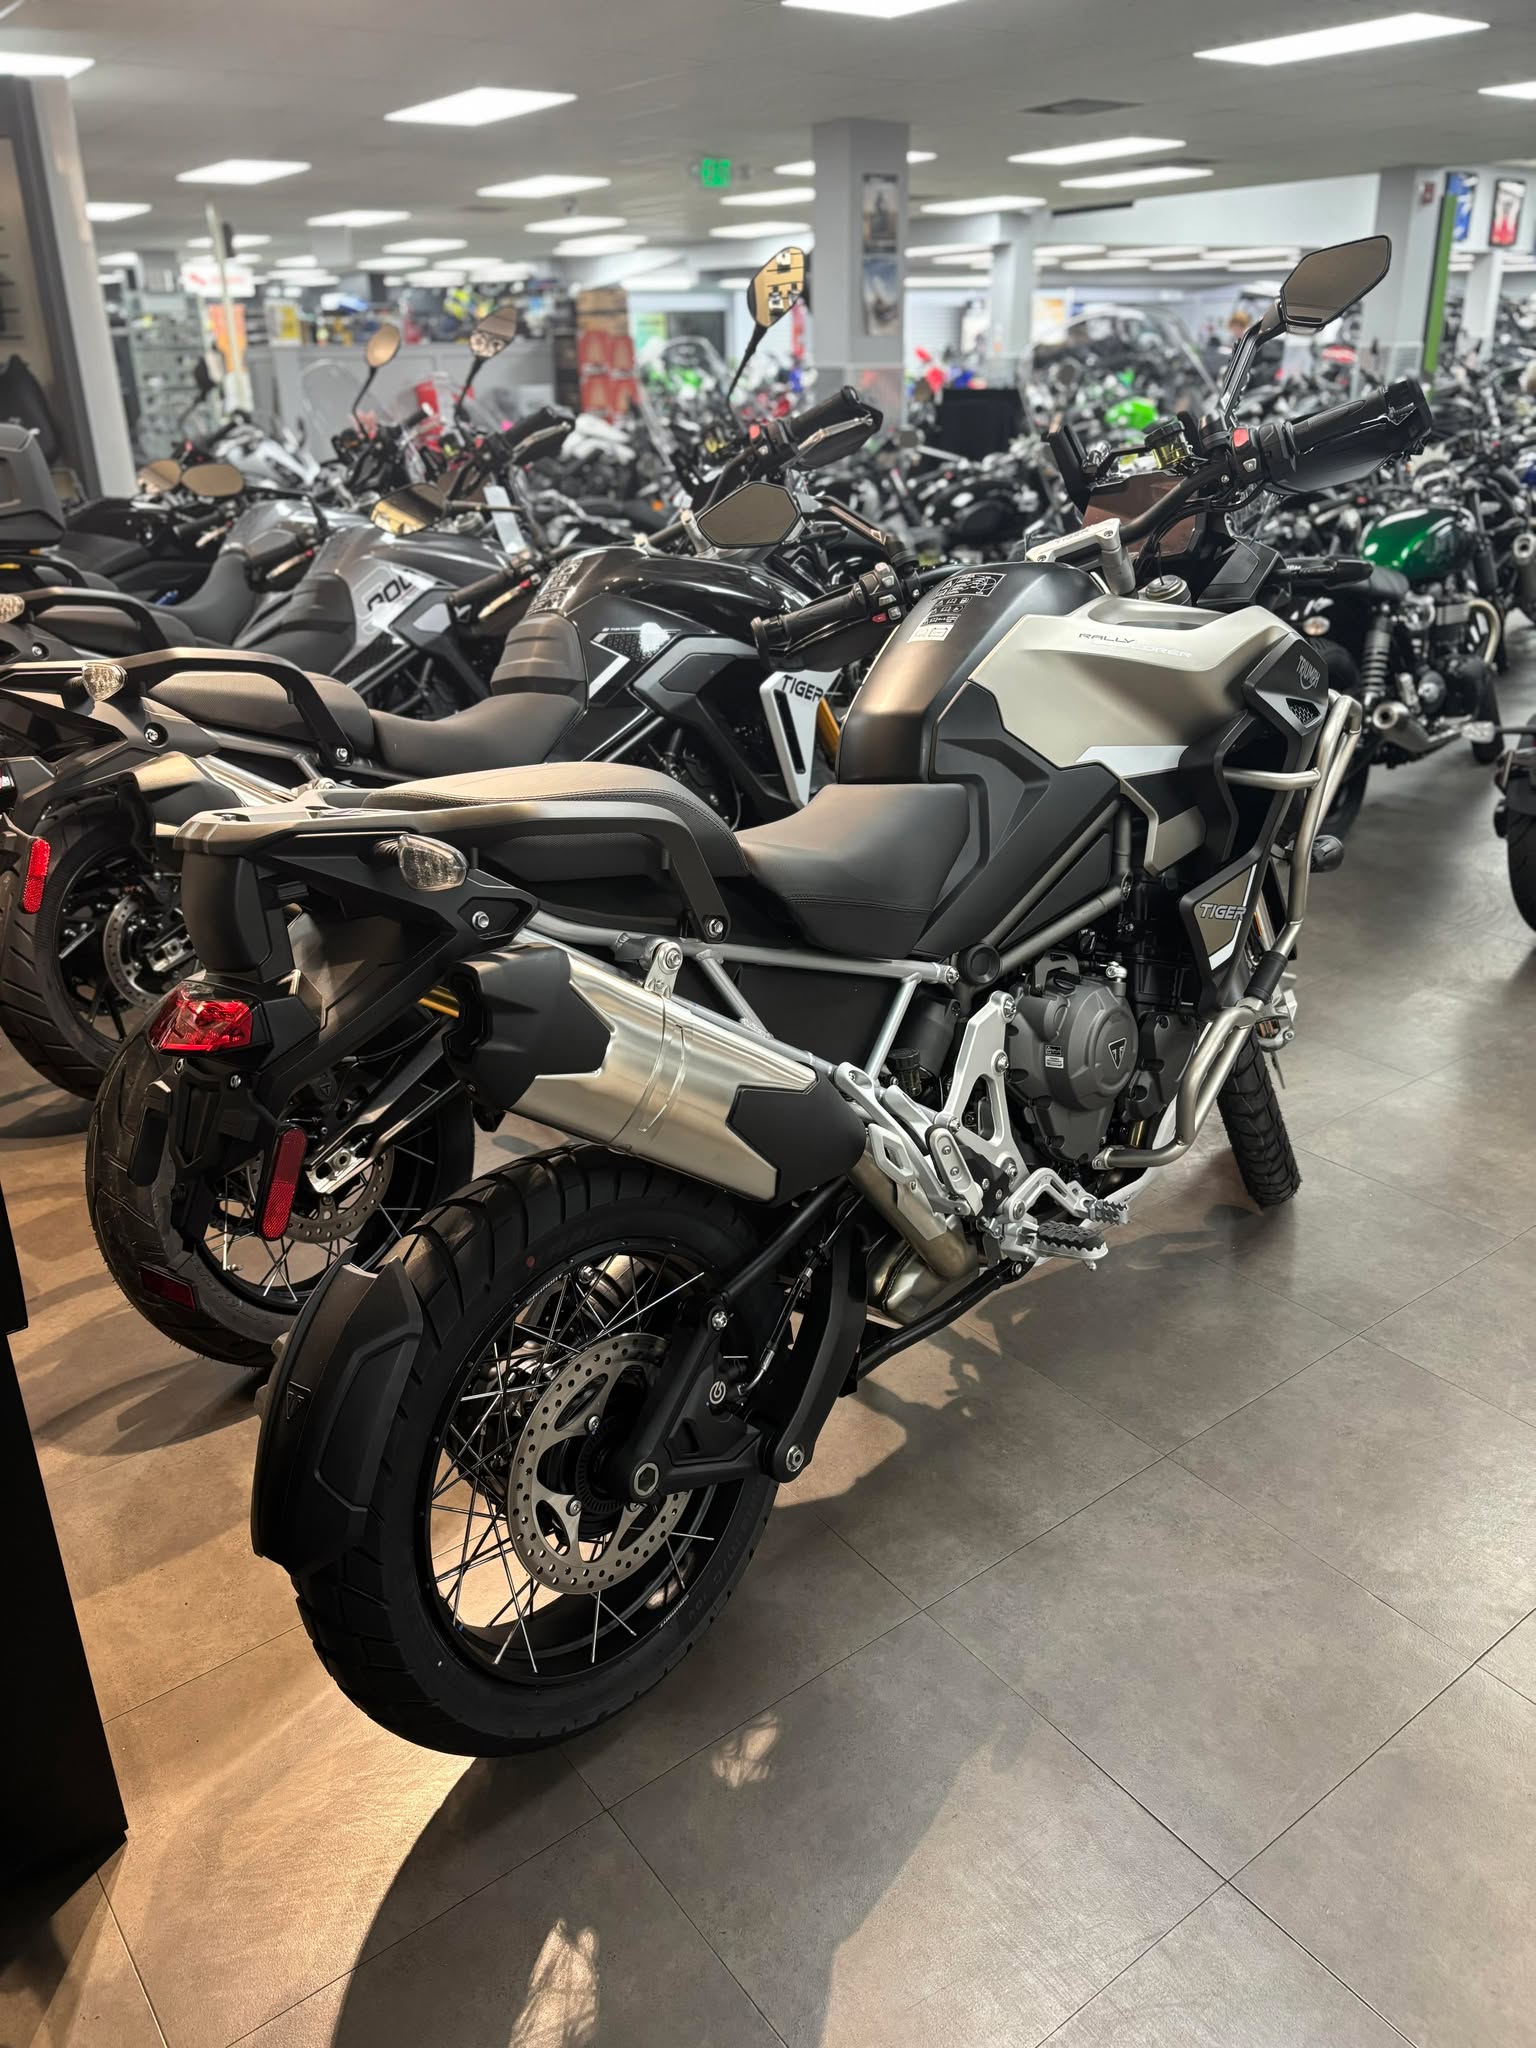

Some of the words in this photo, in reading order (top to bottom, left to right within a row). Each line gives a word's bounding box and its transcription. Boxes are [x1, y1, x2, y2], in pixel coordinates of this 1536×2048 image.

[1079, 633, 1135, 644] RALLY
[1296, 655, 1321, 688] TRIUMPH
[782, 674, 824, 702] TIGER
[1200, 903, 1247, 920] TIGER
